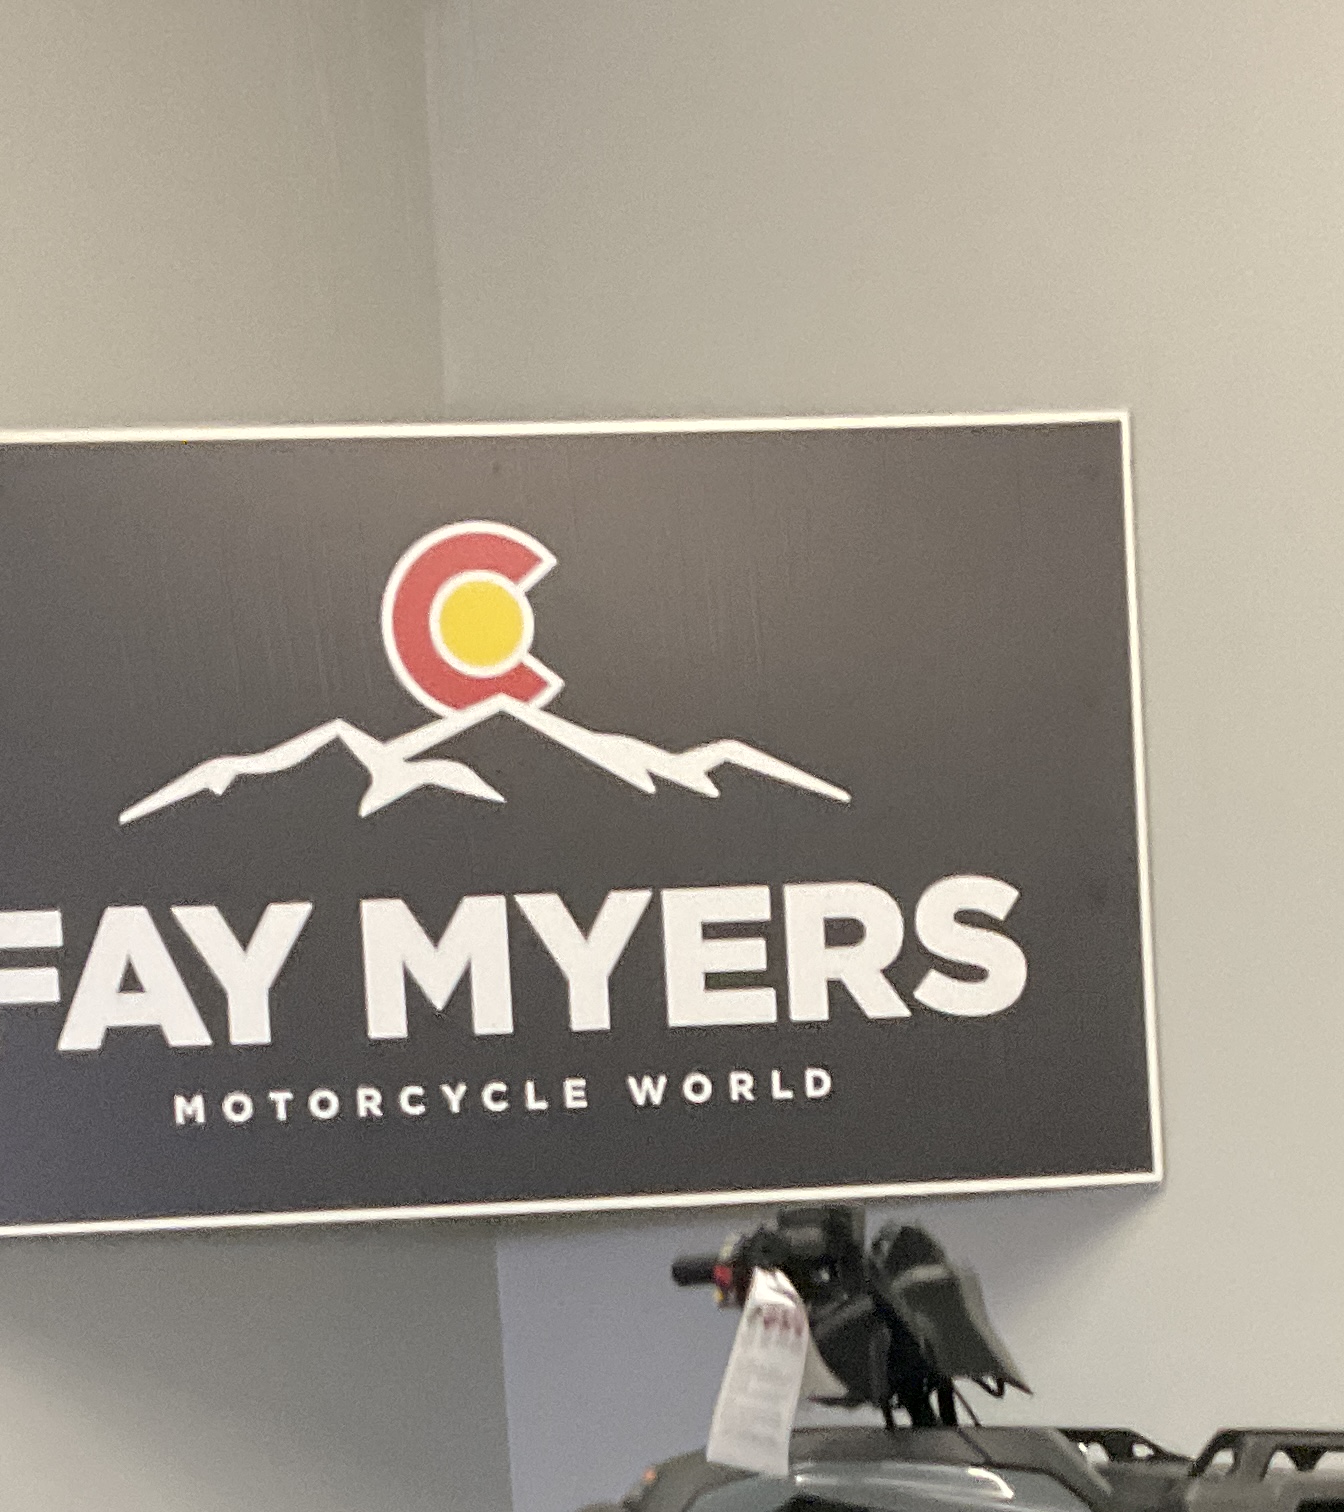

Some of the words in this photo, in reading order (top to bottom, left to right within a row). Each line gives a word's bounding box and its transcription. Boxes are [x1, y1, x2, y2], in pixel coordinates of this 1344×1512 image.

[360, 875, 1027, 1039] MYERS
[174, 1079, 587, 1124] MOTORCYCLE
[627, 1068, 831, 1105] WORLD
